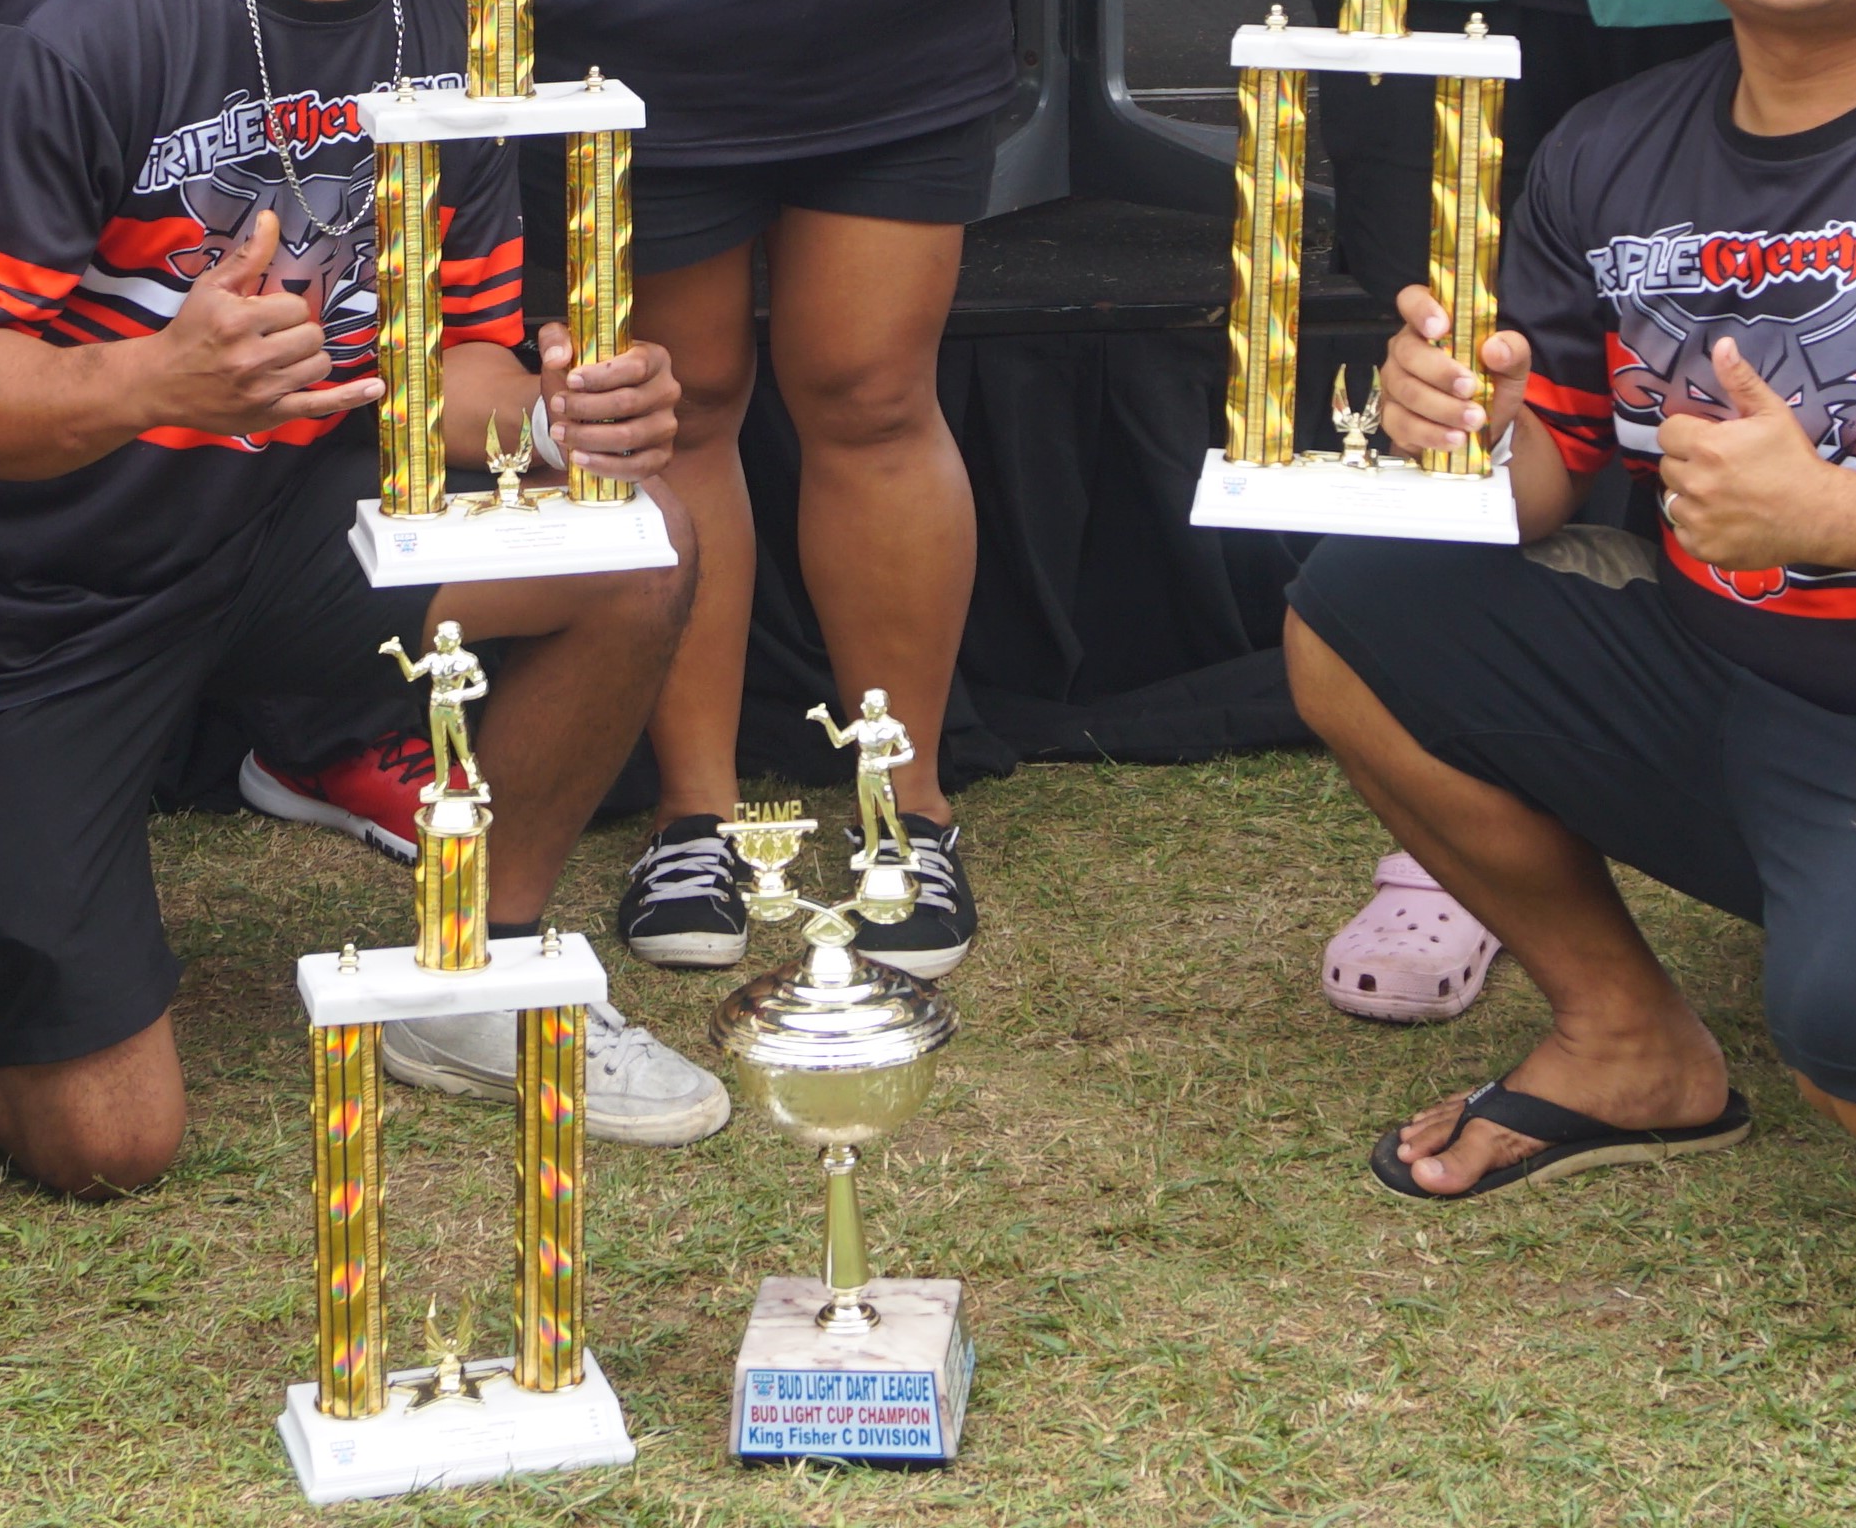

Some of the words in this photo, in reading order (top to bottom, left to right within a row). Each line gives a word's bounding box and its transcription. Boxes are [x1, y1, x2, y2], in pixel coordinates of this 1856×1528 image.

[733, 799, 803, 824] CHAMP
[778, 1374, 803, 1401] BUD
[807, 1375, 842, 1401] LIGHT
[846, 1375, 877, 1402] DART
[881, 1376, 930, 1402] LEAGUE
[750, 1405, 779, 1423] BUD
[782, 1406, 822, 1424] LIGHT
[827, 1406, 854, 1424] CUP
[858, 1407, 931, 1425] CHAMPION
[748, 1426, 784, 1449] King
[789, 1427, 837, 1446] Fisher
[842, 1428, 853, 1446] C
[858, 1428, 931, 1447] DIVISION
